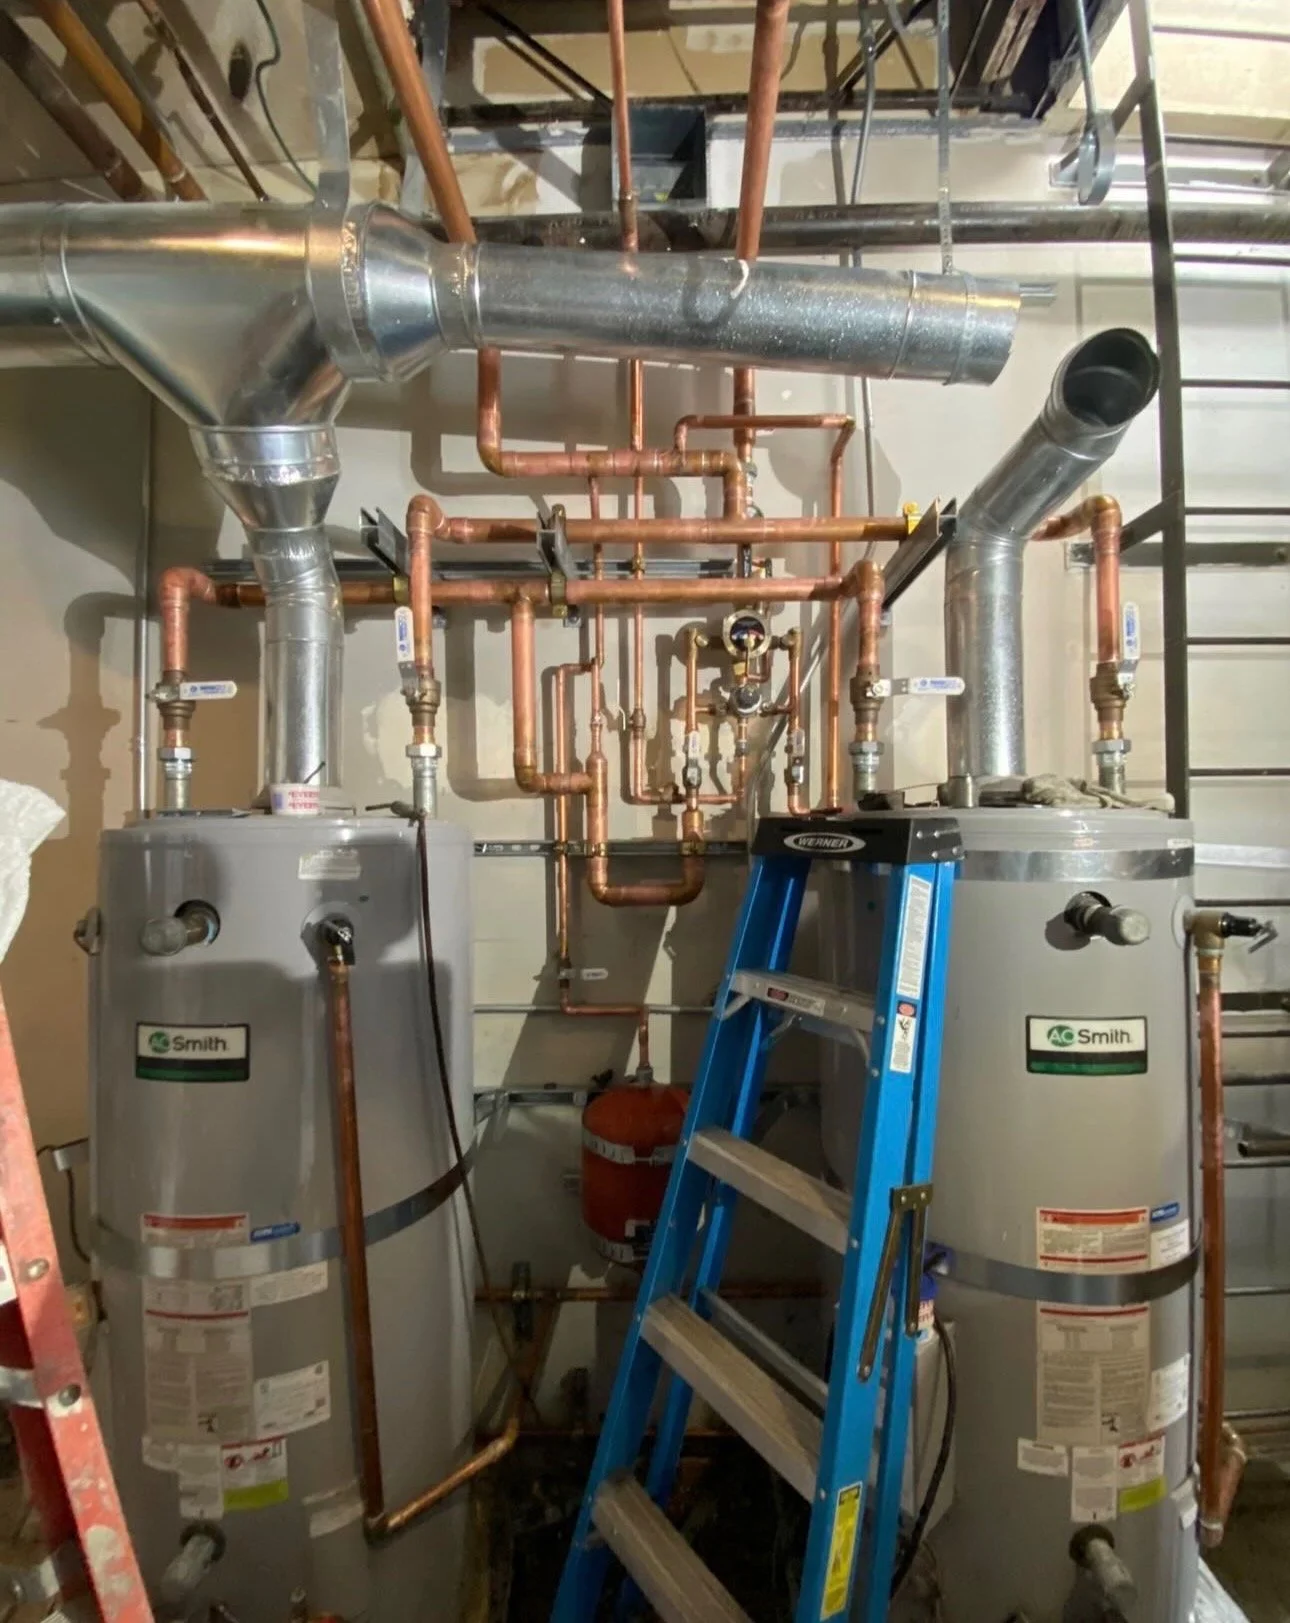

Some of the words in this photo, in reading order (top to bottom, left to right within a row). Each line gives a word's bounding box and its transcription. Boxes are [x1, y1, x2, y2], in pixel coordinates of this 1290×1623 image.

[798, 837, 849, 848] WERNER
[172, 1034, 227, 1052] Smith
[1078, 1028, 1131, 1045] Smith
